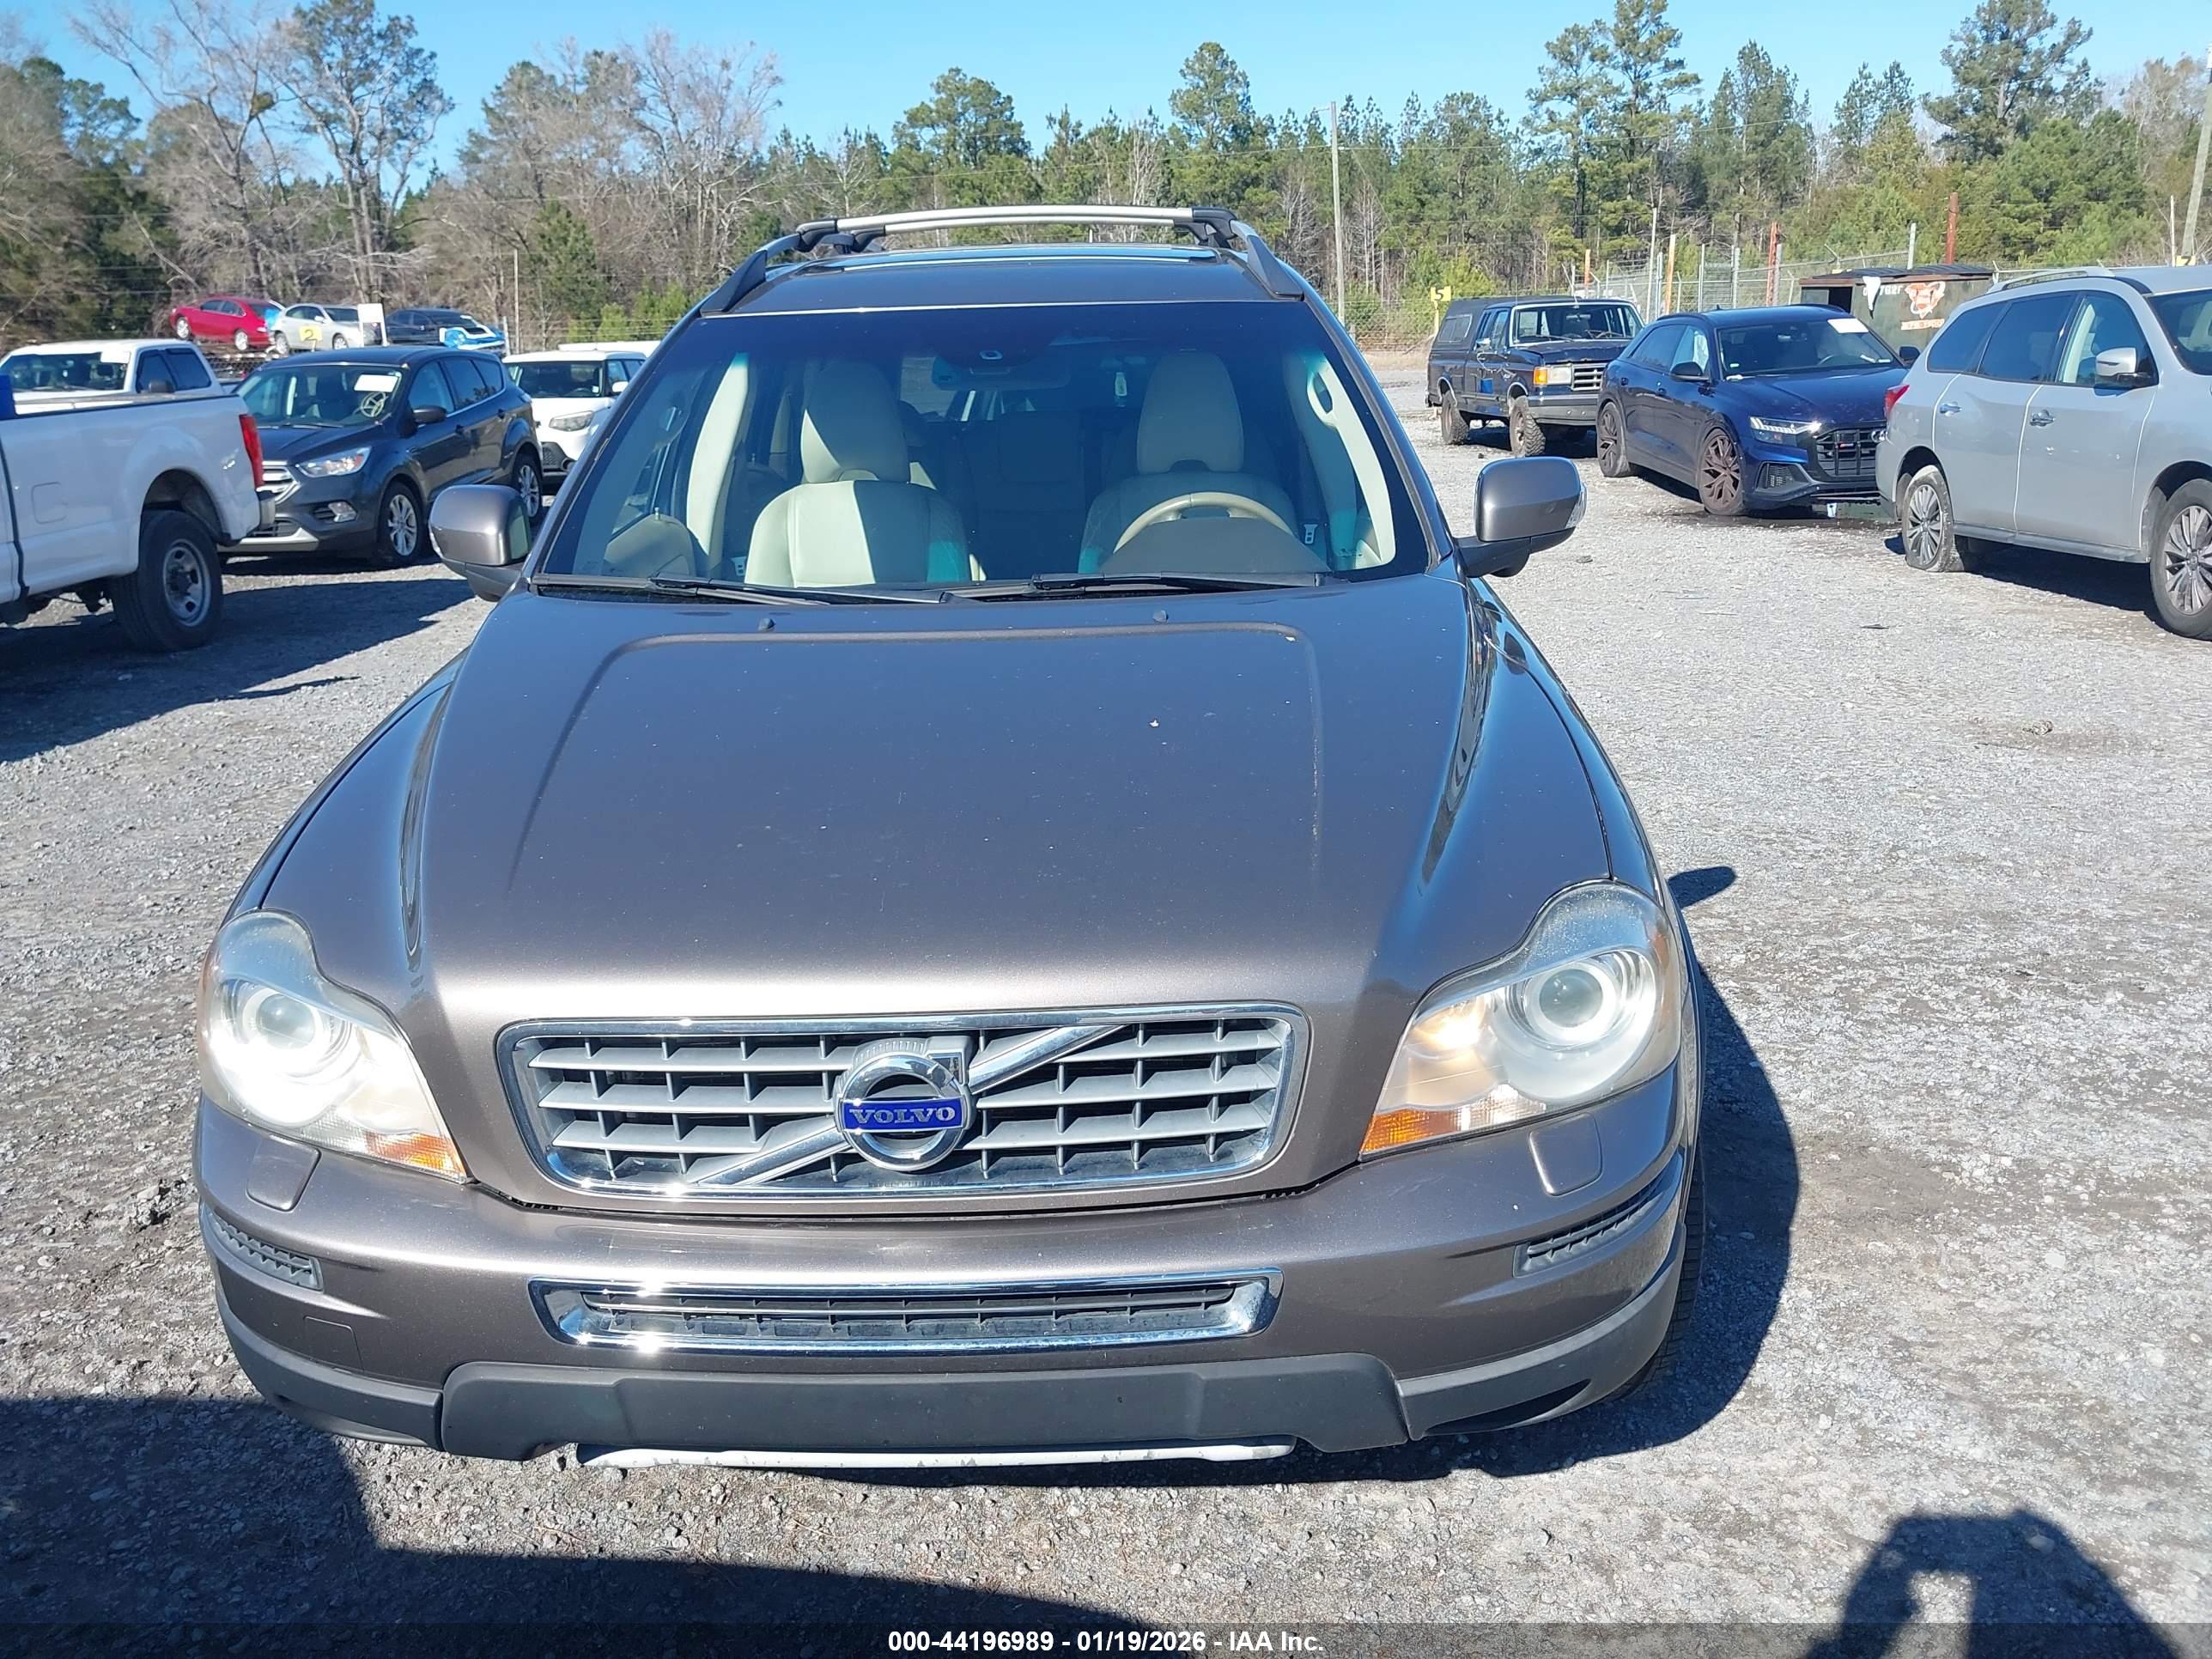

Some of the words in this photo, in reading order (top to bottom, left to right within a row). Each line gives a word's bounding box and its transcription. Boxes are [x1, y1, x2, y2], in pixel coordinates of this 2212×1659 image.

[1434, 288, 1444, 301] 5
[304, 329, 317, 341] 2
[848, 1106, 956, 1124] VOLVO
